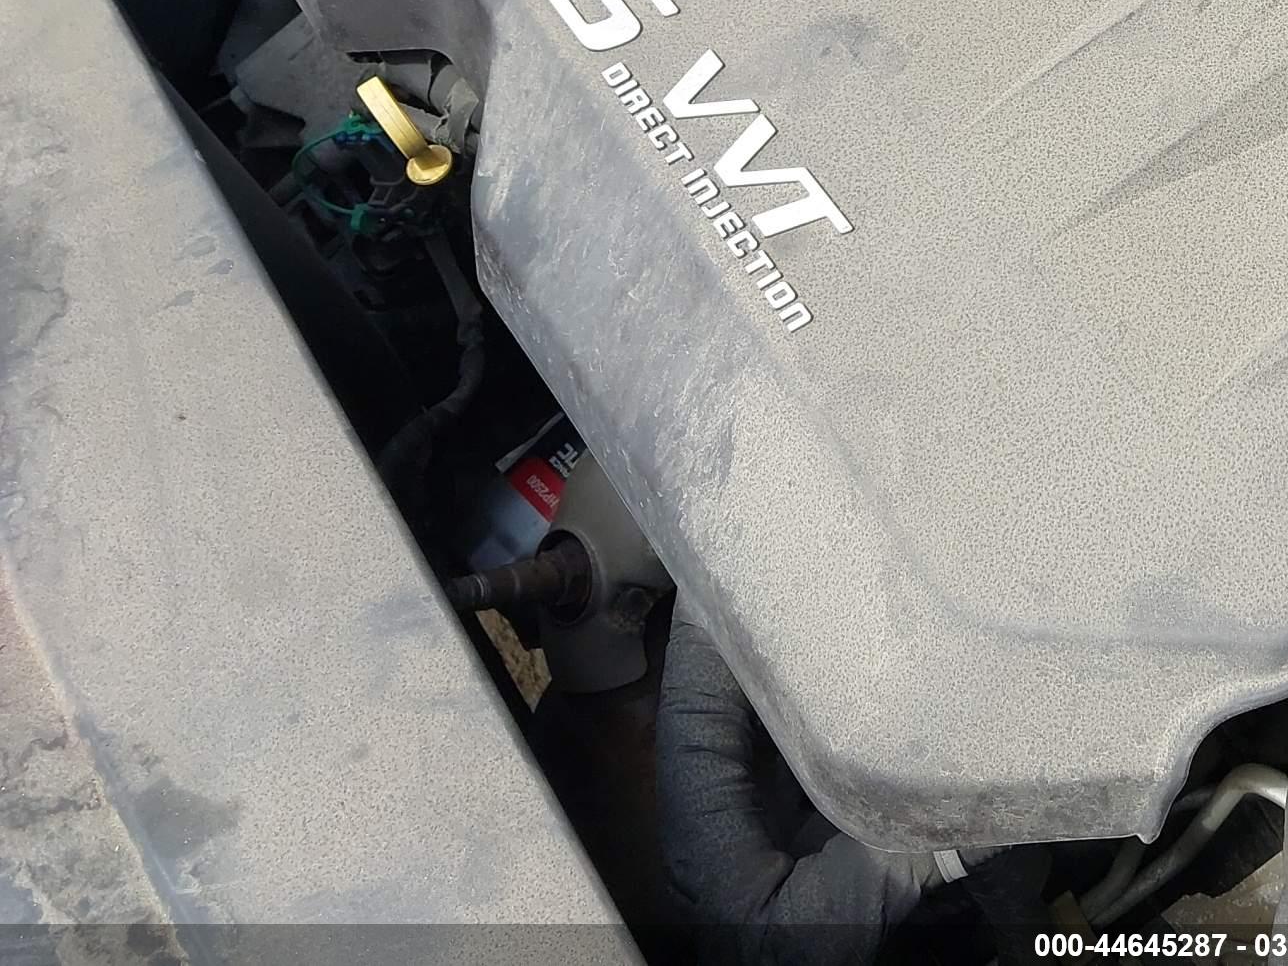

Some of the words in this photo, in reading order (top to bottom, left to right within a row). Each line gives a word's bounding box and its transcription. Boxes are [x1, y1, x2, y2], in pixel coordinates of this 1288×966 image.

[601, 61, 694, 165] DIRECT
[681, 168, 813, 333] INJECTION
[662, 49, 855, 238] VVT
[526, 475, 560, 508] HP2500
